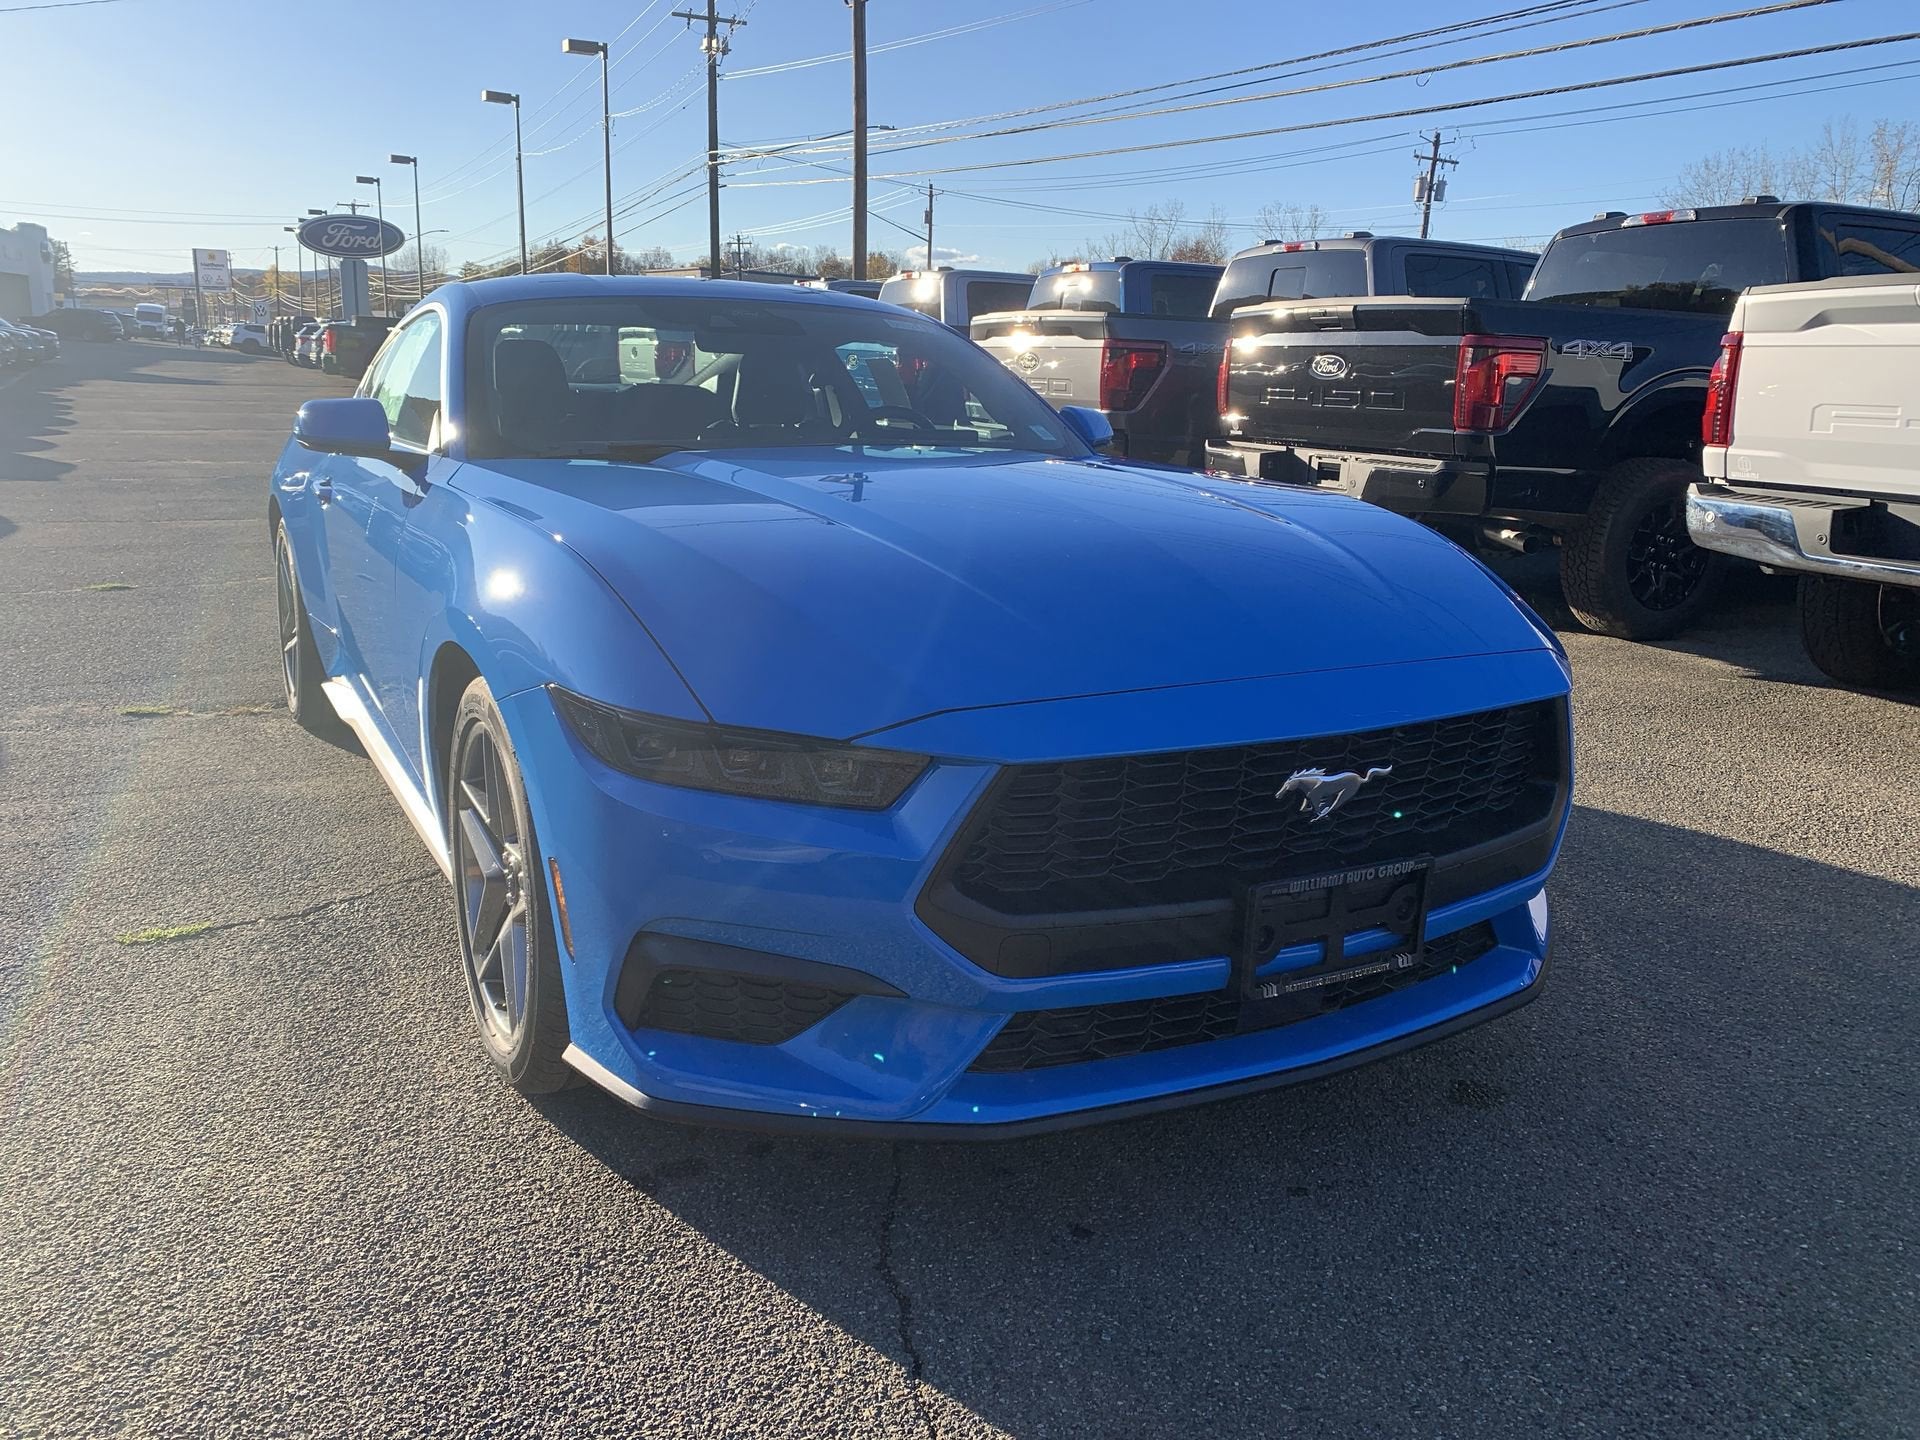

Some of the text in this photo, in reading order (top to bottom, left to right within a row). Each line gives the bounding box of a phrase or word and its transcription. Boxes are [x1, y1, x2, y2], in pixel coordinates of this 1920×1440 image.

[322, 223, 382, 249] Ford
[1315, 357, 1340, 374] Ford
[1259, 386, 1406, 411] F-150
[1346, 868, 1376, 884] AUTO
